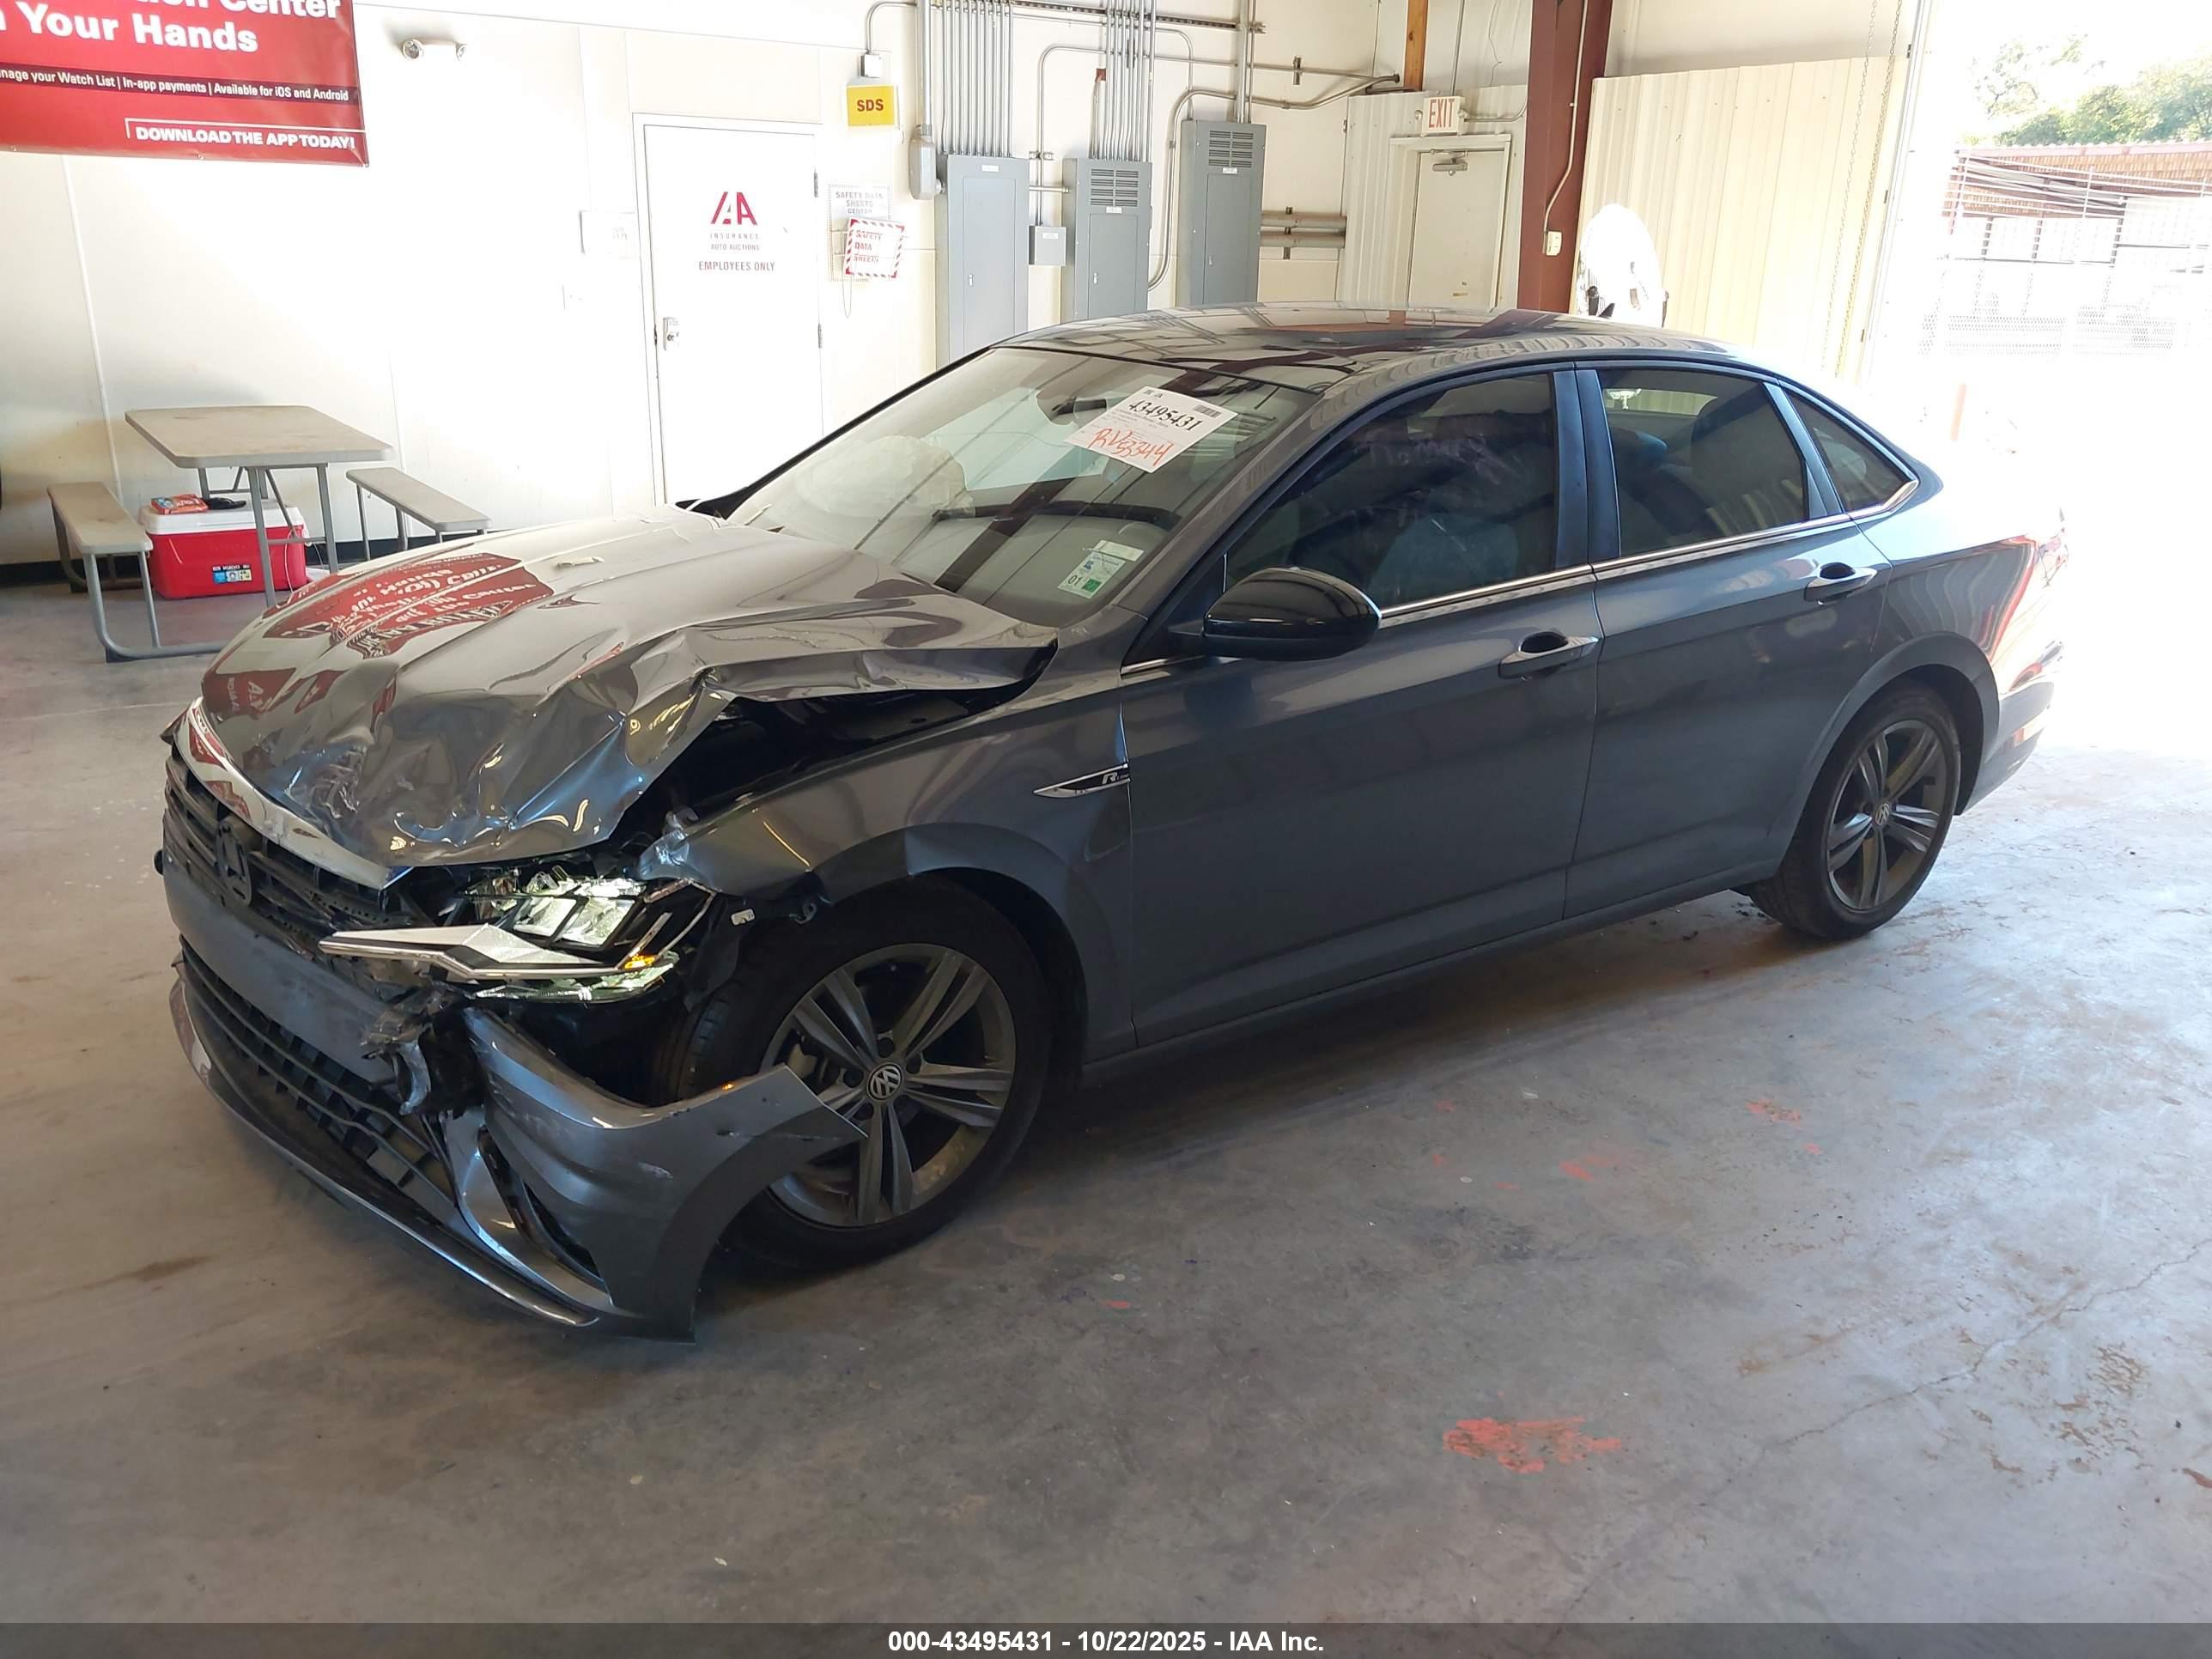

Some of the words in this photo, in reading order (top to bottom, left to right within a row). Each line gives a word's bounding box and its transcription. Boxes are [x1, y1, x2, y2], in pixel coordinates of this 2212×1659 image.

[16, 1, 119, 41] Your
[131, 13, 258, 52] Hands
[31, 71, 56, 83] your
[57, 71, 94, 86] Watch
[95, 75, 115, 87] List
[122, 76, 156, 92] In-app
[158, 82, 206, 94] payments
[214, 83, 258, 96] Available
[259, 85, 273, 96] for
[275, 87, 291, 97] iOS
[294, 88, 311, 99] and
[313, 89, 349, 101] Android
[856, 98, 884, 112] SDS
[1428, 98, 1455, 128] EXIT
[136, 126, 231, 144] DOWNLOAD
[232, 131, 263, 144] THE
[266, 133, 298, 147] APP
[298, 134, 356, 149] TODAY!
[836, 191, 862, 199] SAFETY
[846, 199, 873, 208] SHEETS
[854, 241, 872, 251] DATA
[698, 260, 751, 271] EMPLOYEES
[754, 261, 775, 272] ONLY
[1128, 399, 1203, 431] 43495431
